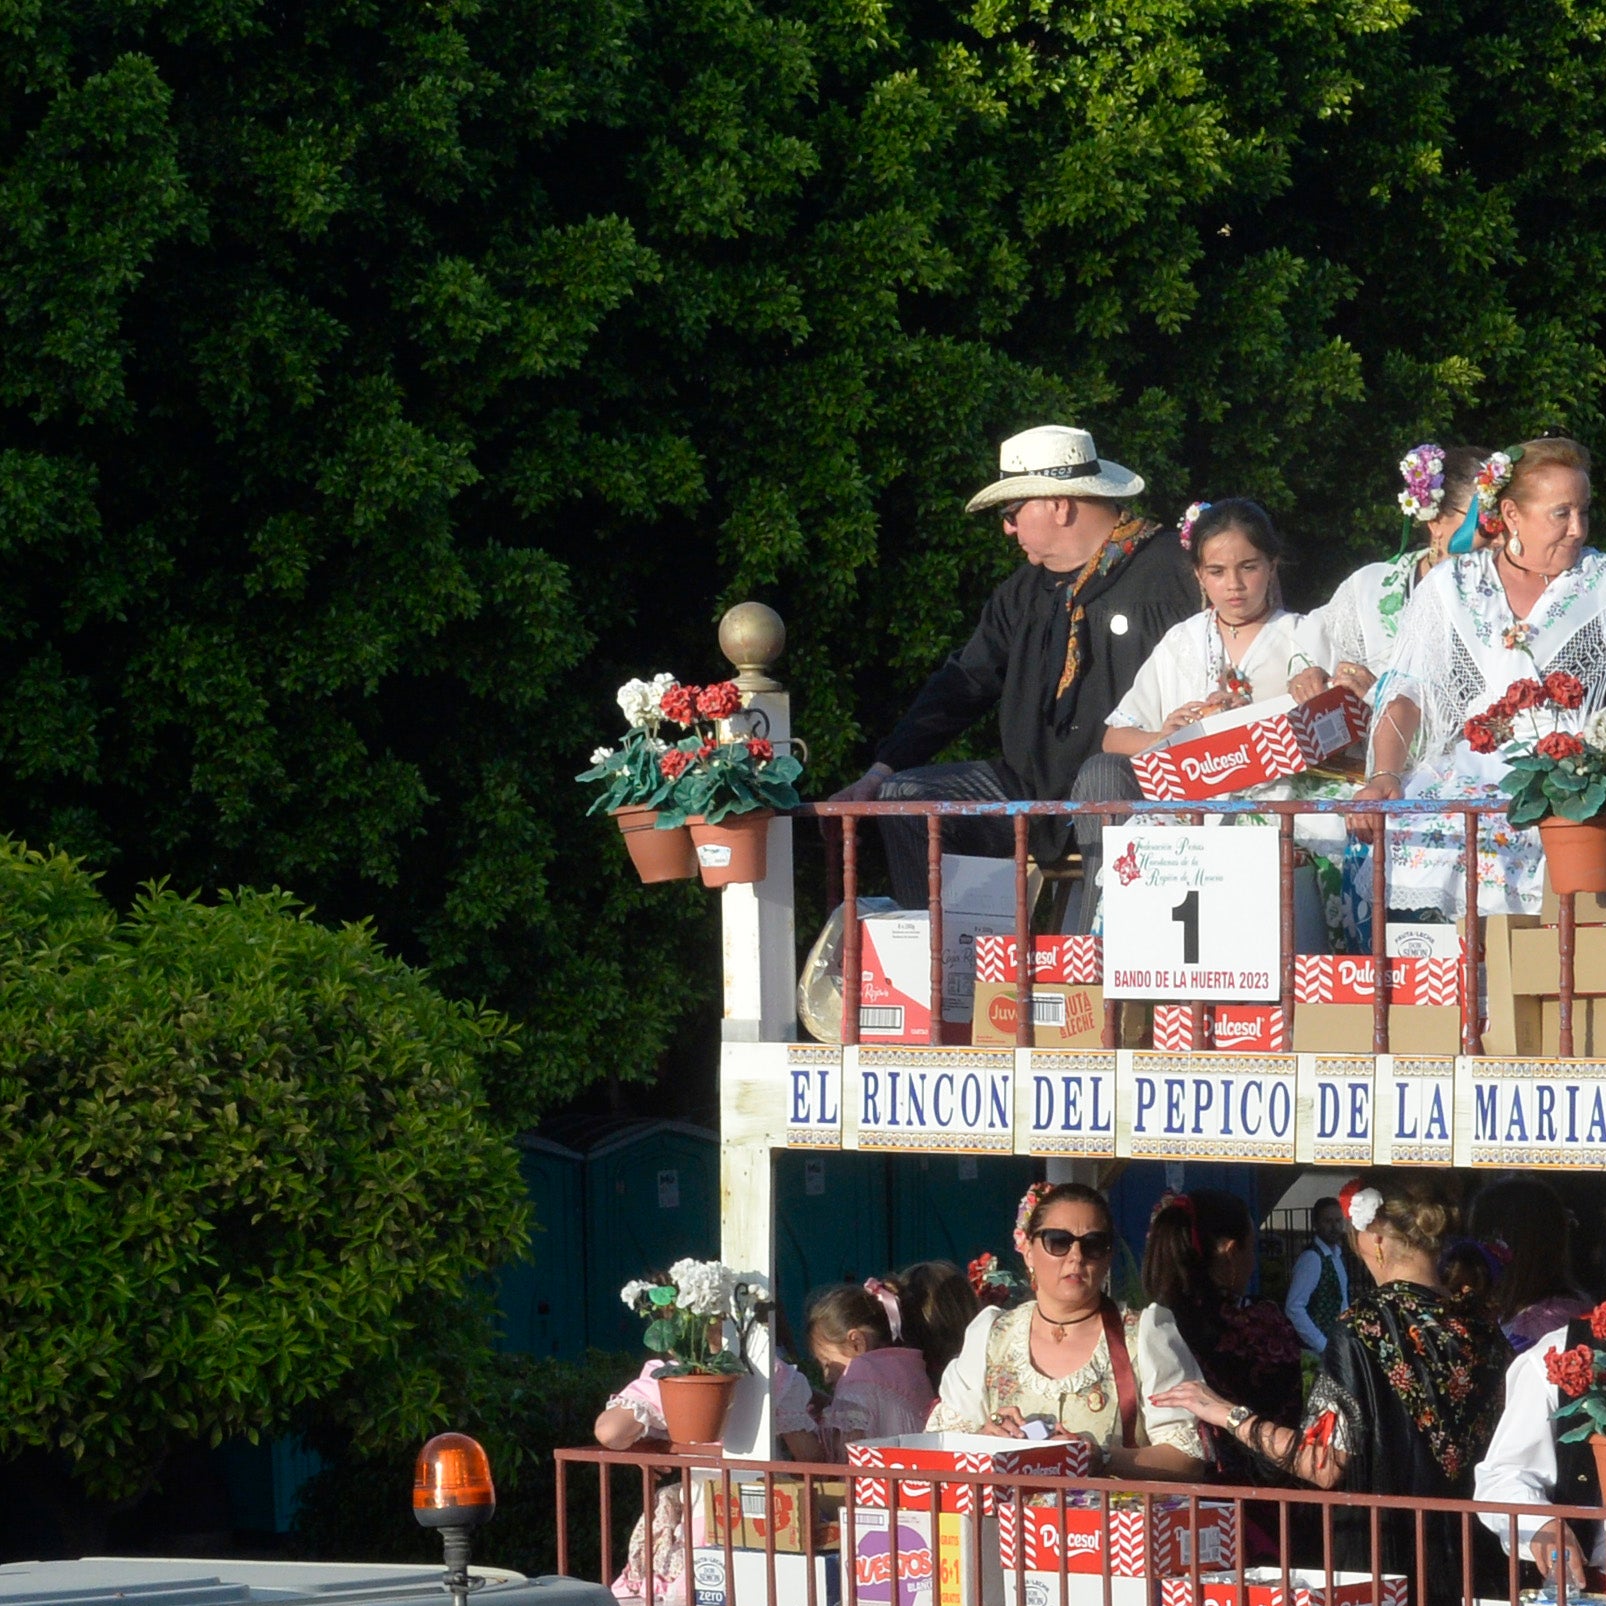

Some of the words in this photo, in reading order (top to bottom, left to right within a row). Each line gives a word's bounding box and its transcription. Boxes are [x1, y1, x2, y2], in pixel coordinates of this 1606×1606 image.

[1181, 744, 1251, 781] Dulcesol
[1172, 890, 1199, 964] 1
[1114, 970, 1151, 987] BANDO
[1155, 970, 1169, 988] DE
[1173, 971, 1187, 988] LA
[1191, 971, 1235, 989] HUERTA
[1239, 971, 1269, 989] 2023
[1338, 960, 1406, 986] Dulcsol
[790, 1070, 837, 1124] EL
[861, 1071, 1009, 1128] RINCON
[1032, 1075, 1111, 1131] DEL
[1134, 1077, 1291, 1137] PEPICO
[1317, 1082, 1369, 1139] DE
[1394, 1082, 1449, 1139] LA
[1039, 1524, 1100, 1549] Ducesol
[699, 1590, 723, 1602] zero
